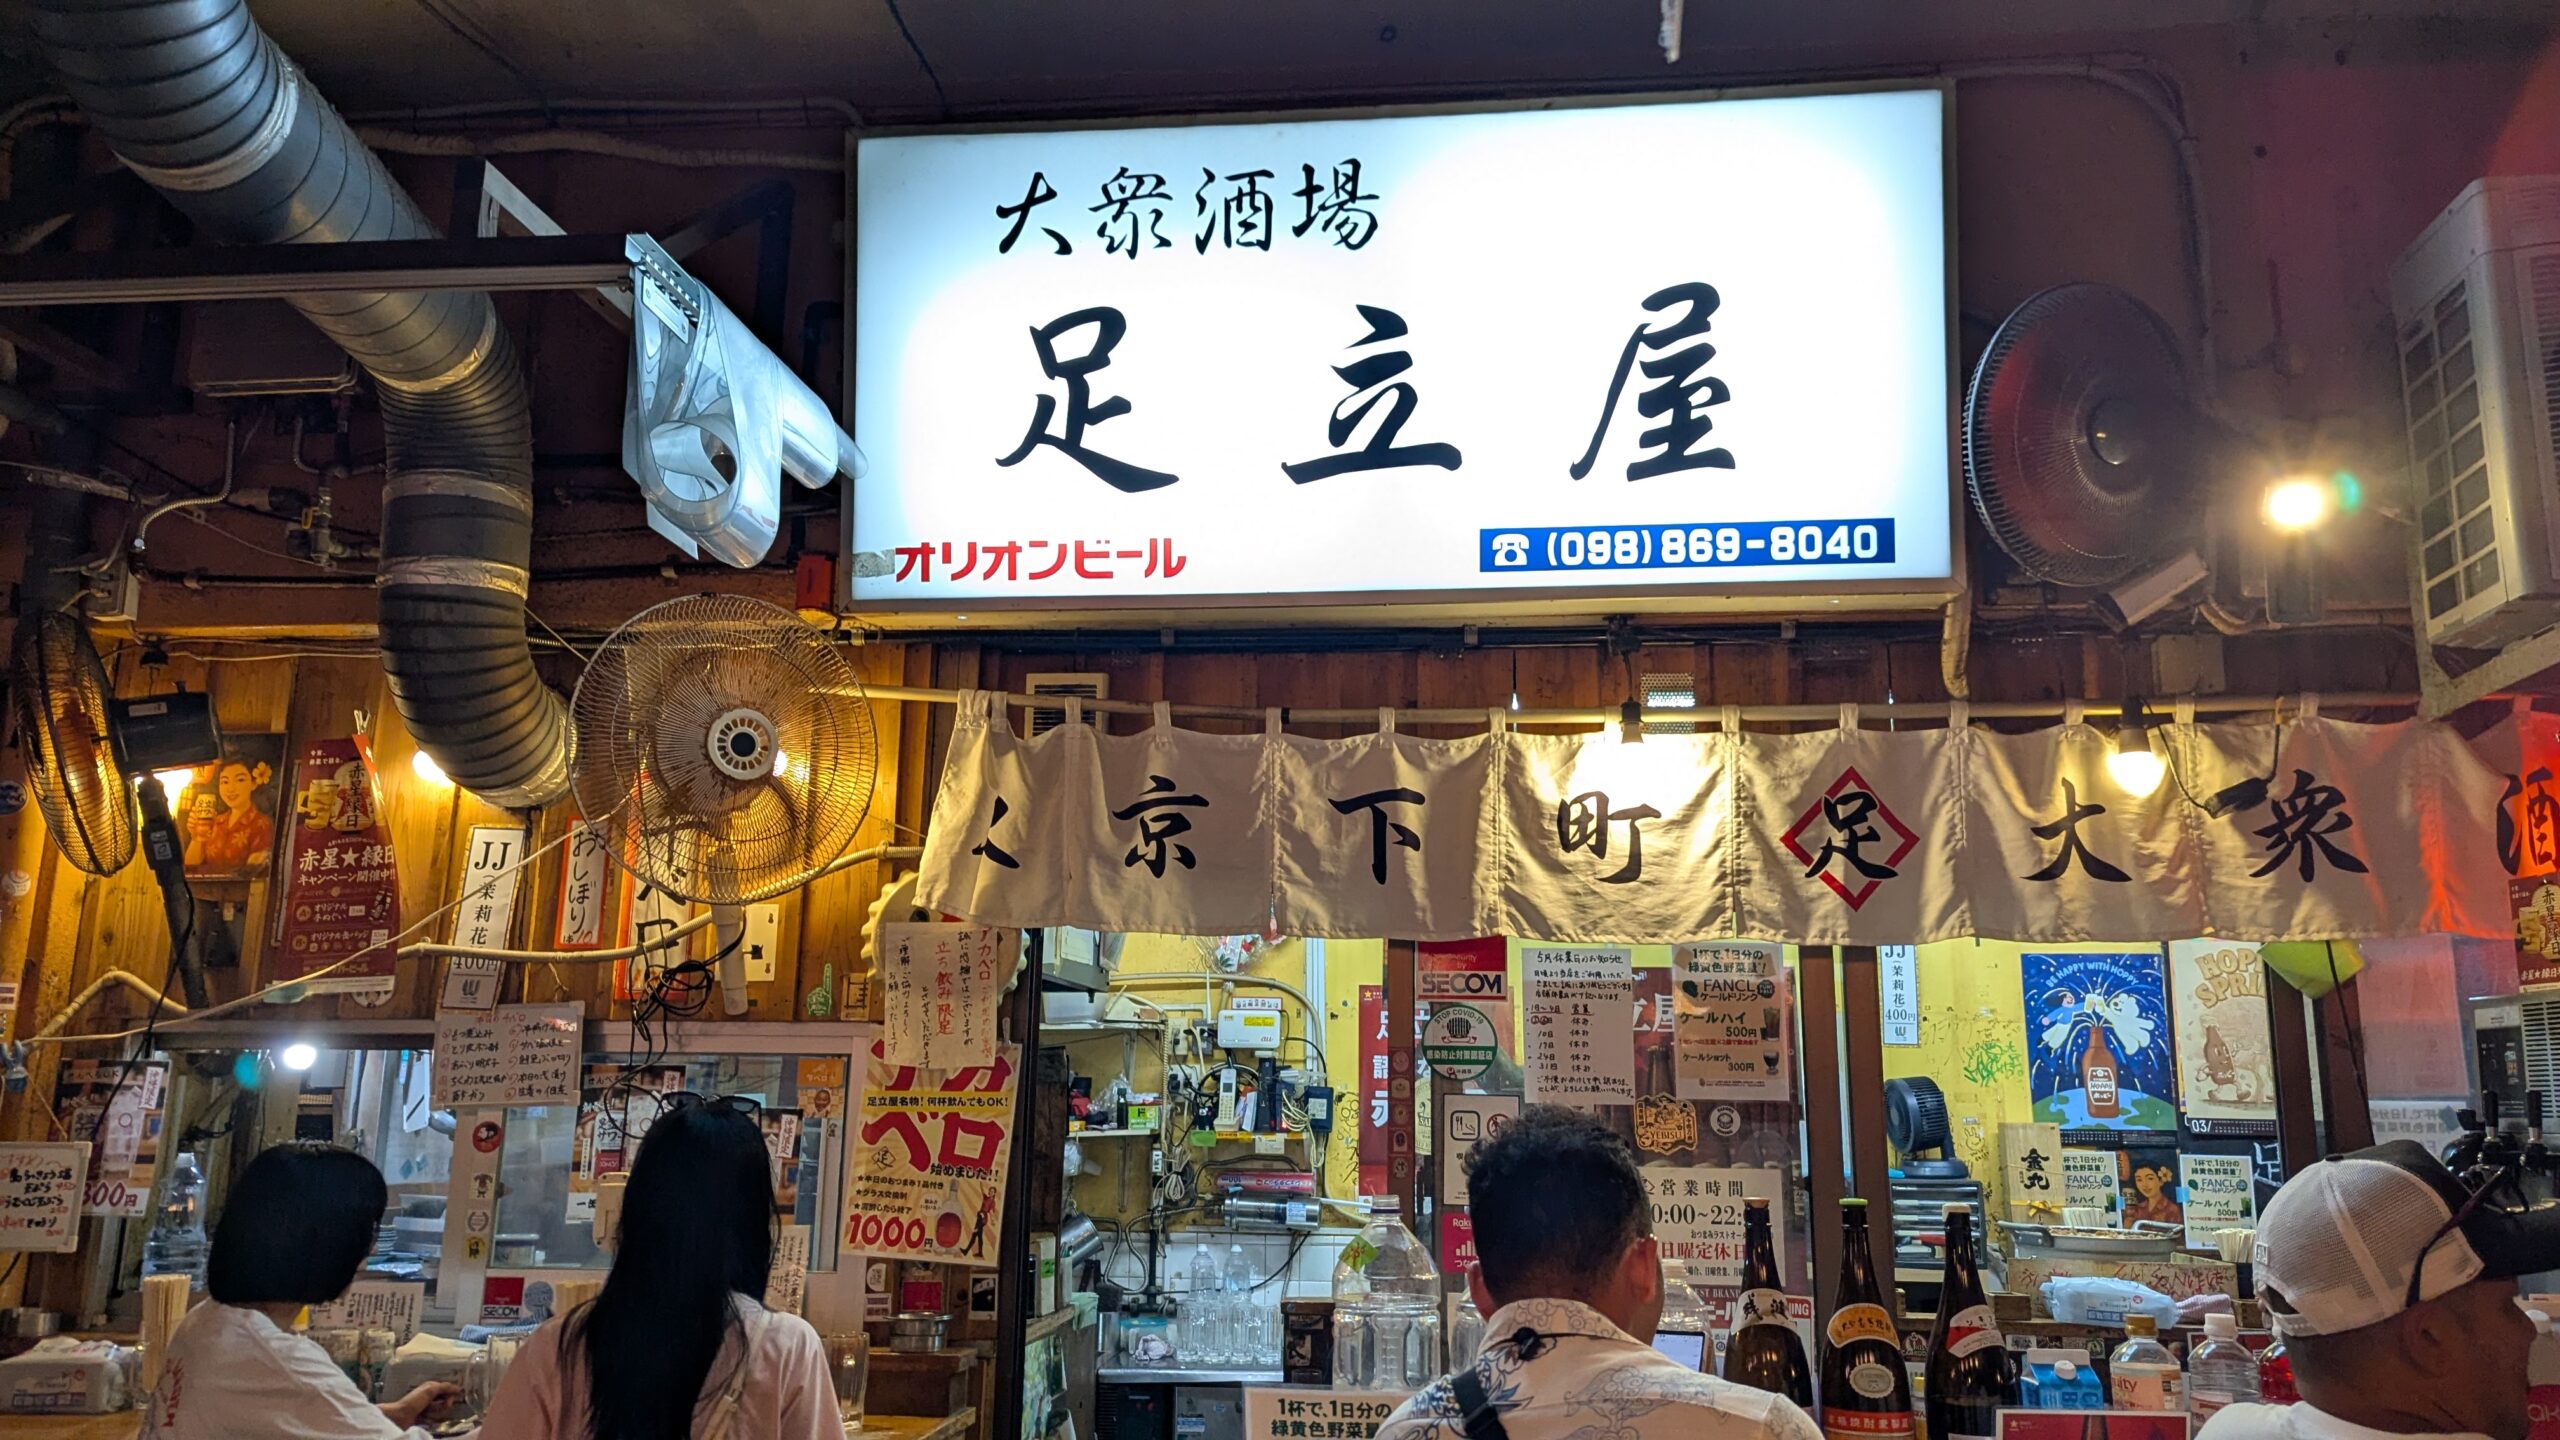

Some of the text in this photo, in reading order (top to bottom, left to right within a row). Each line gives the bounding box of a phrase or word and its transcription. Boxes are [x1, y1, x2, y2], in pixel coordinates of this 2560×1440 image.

[996, 157, 1380, 261] 大衆酒場
[995, 281, 1737, 493] 足立屋
[1547, 525, 1878, 566] (098)869-8040
[896, 538, 1187, 582] オリオンビール
[1804, 791, 1899, 880] 足
[473, 841, 512, 871] JJ
[568, 829, 598, 934] おしぼり
[1422, 972, 1502, 994] SECOM
[2046, 961, 2140, 988] BE HAPPY WITH HOPPY
[936, 940, 955, 1036] 立ち飲み限定
[1703, 979, 1756, 992] FANCL
[1700, 992, 1759, 1002] ケールドリンク
[1434, 1008, 1485, 1026] STOP COVID-19
[1679, 1012, 1747, 1025] ケールハイ
[1885, 1008, 1916, 1022] 400円
[1725, 1026, 1758, 1038] 500円
[1682, 1053, 1732, 1063] ケールショット
[1727, 1062, 1755, 1072] 300円
[930, 1163, 999, 1182] 始めました!!
[2067, 1175, 2101, 1184] FANCL
[1661, 1179, 1744, 1197] 営業時間
[2201, 1179, 2236, 1188] FANCL
[2217, 1208, 2238, 1217] 500円
[849, 1212, 934, 1249] 1000円
[483, 1306, 520, 1317] SECOM
[1278, 1398, 1392, 1419] 1杯で、1日分の
